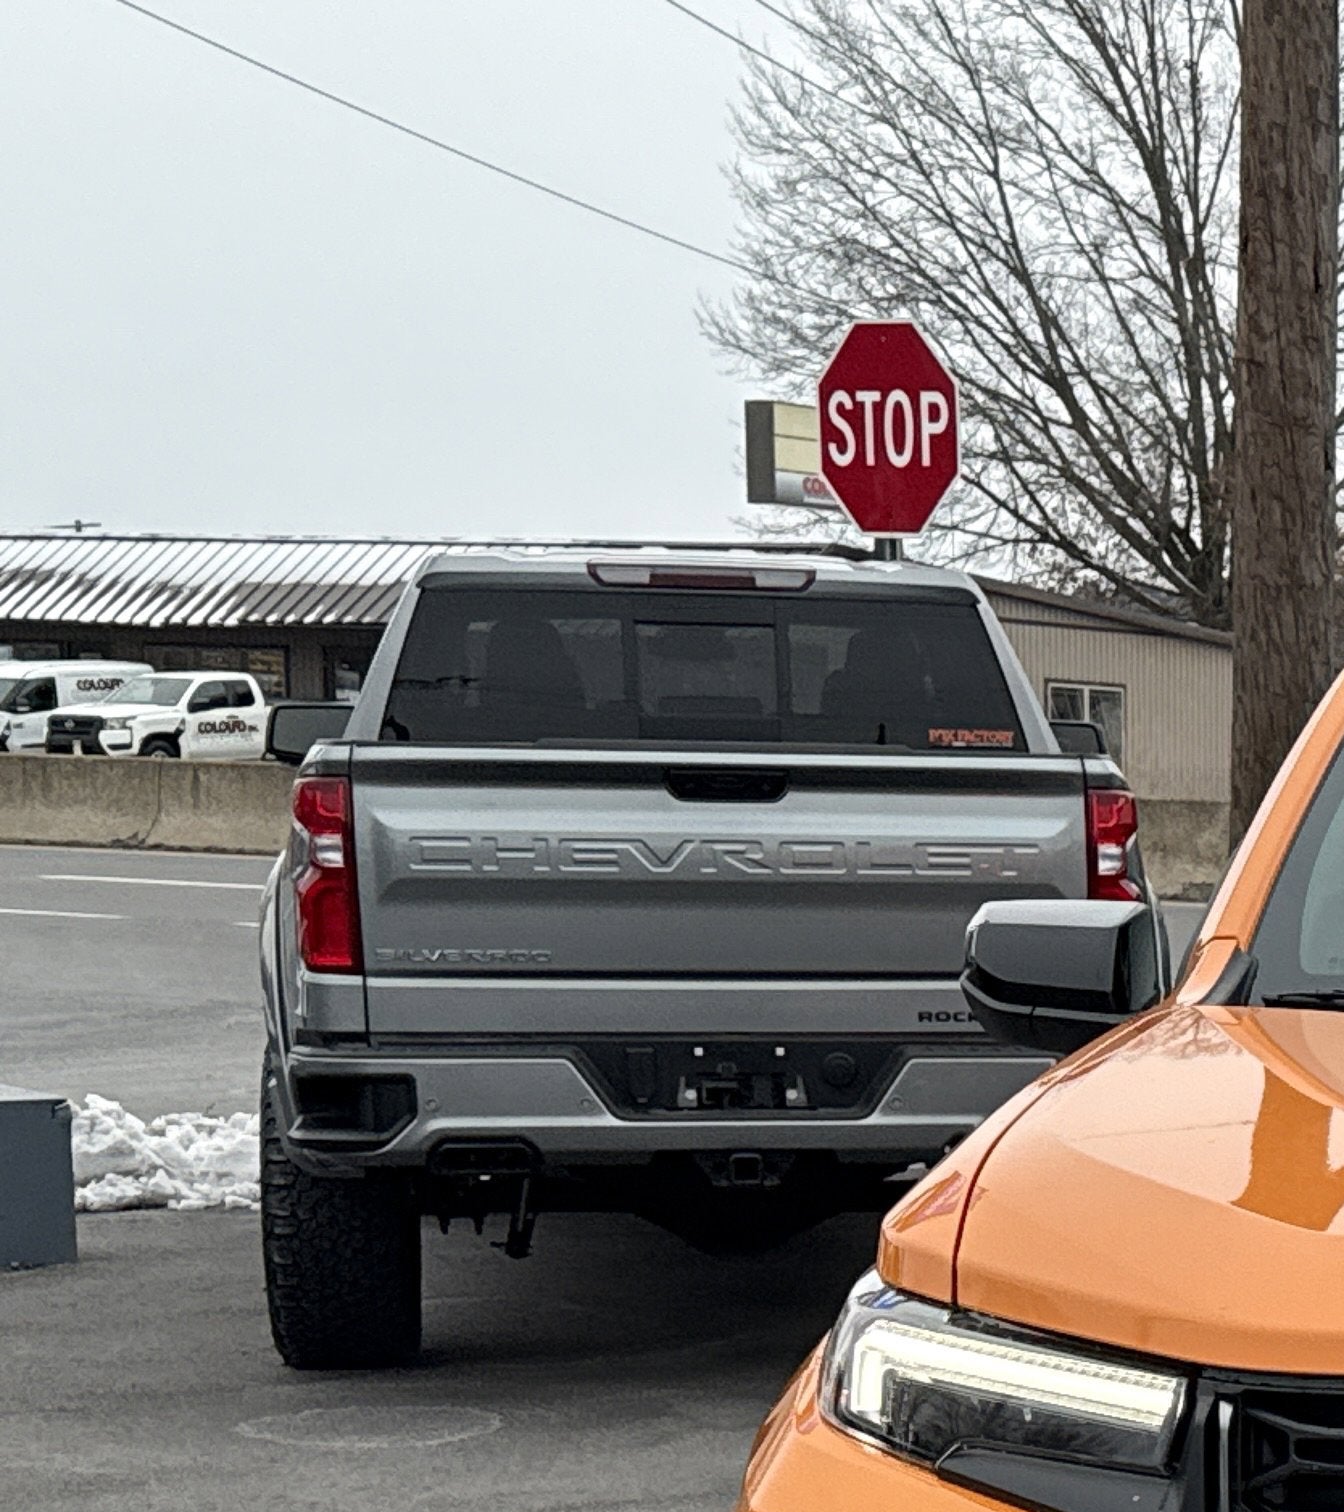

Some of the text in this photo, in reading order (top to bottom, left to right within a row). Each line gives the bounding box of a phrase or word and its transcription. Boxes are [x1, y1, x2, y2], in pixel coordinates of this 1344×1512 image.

[828, 388, 949, 468] STOP
[409, 836, 1040, 877] CHEVROLET
[375, 948, 552, 963] SILVERADO
